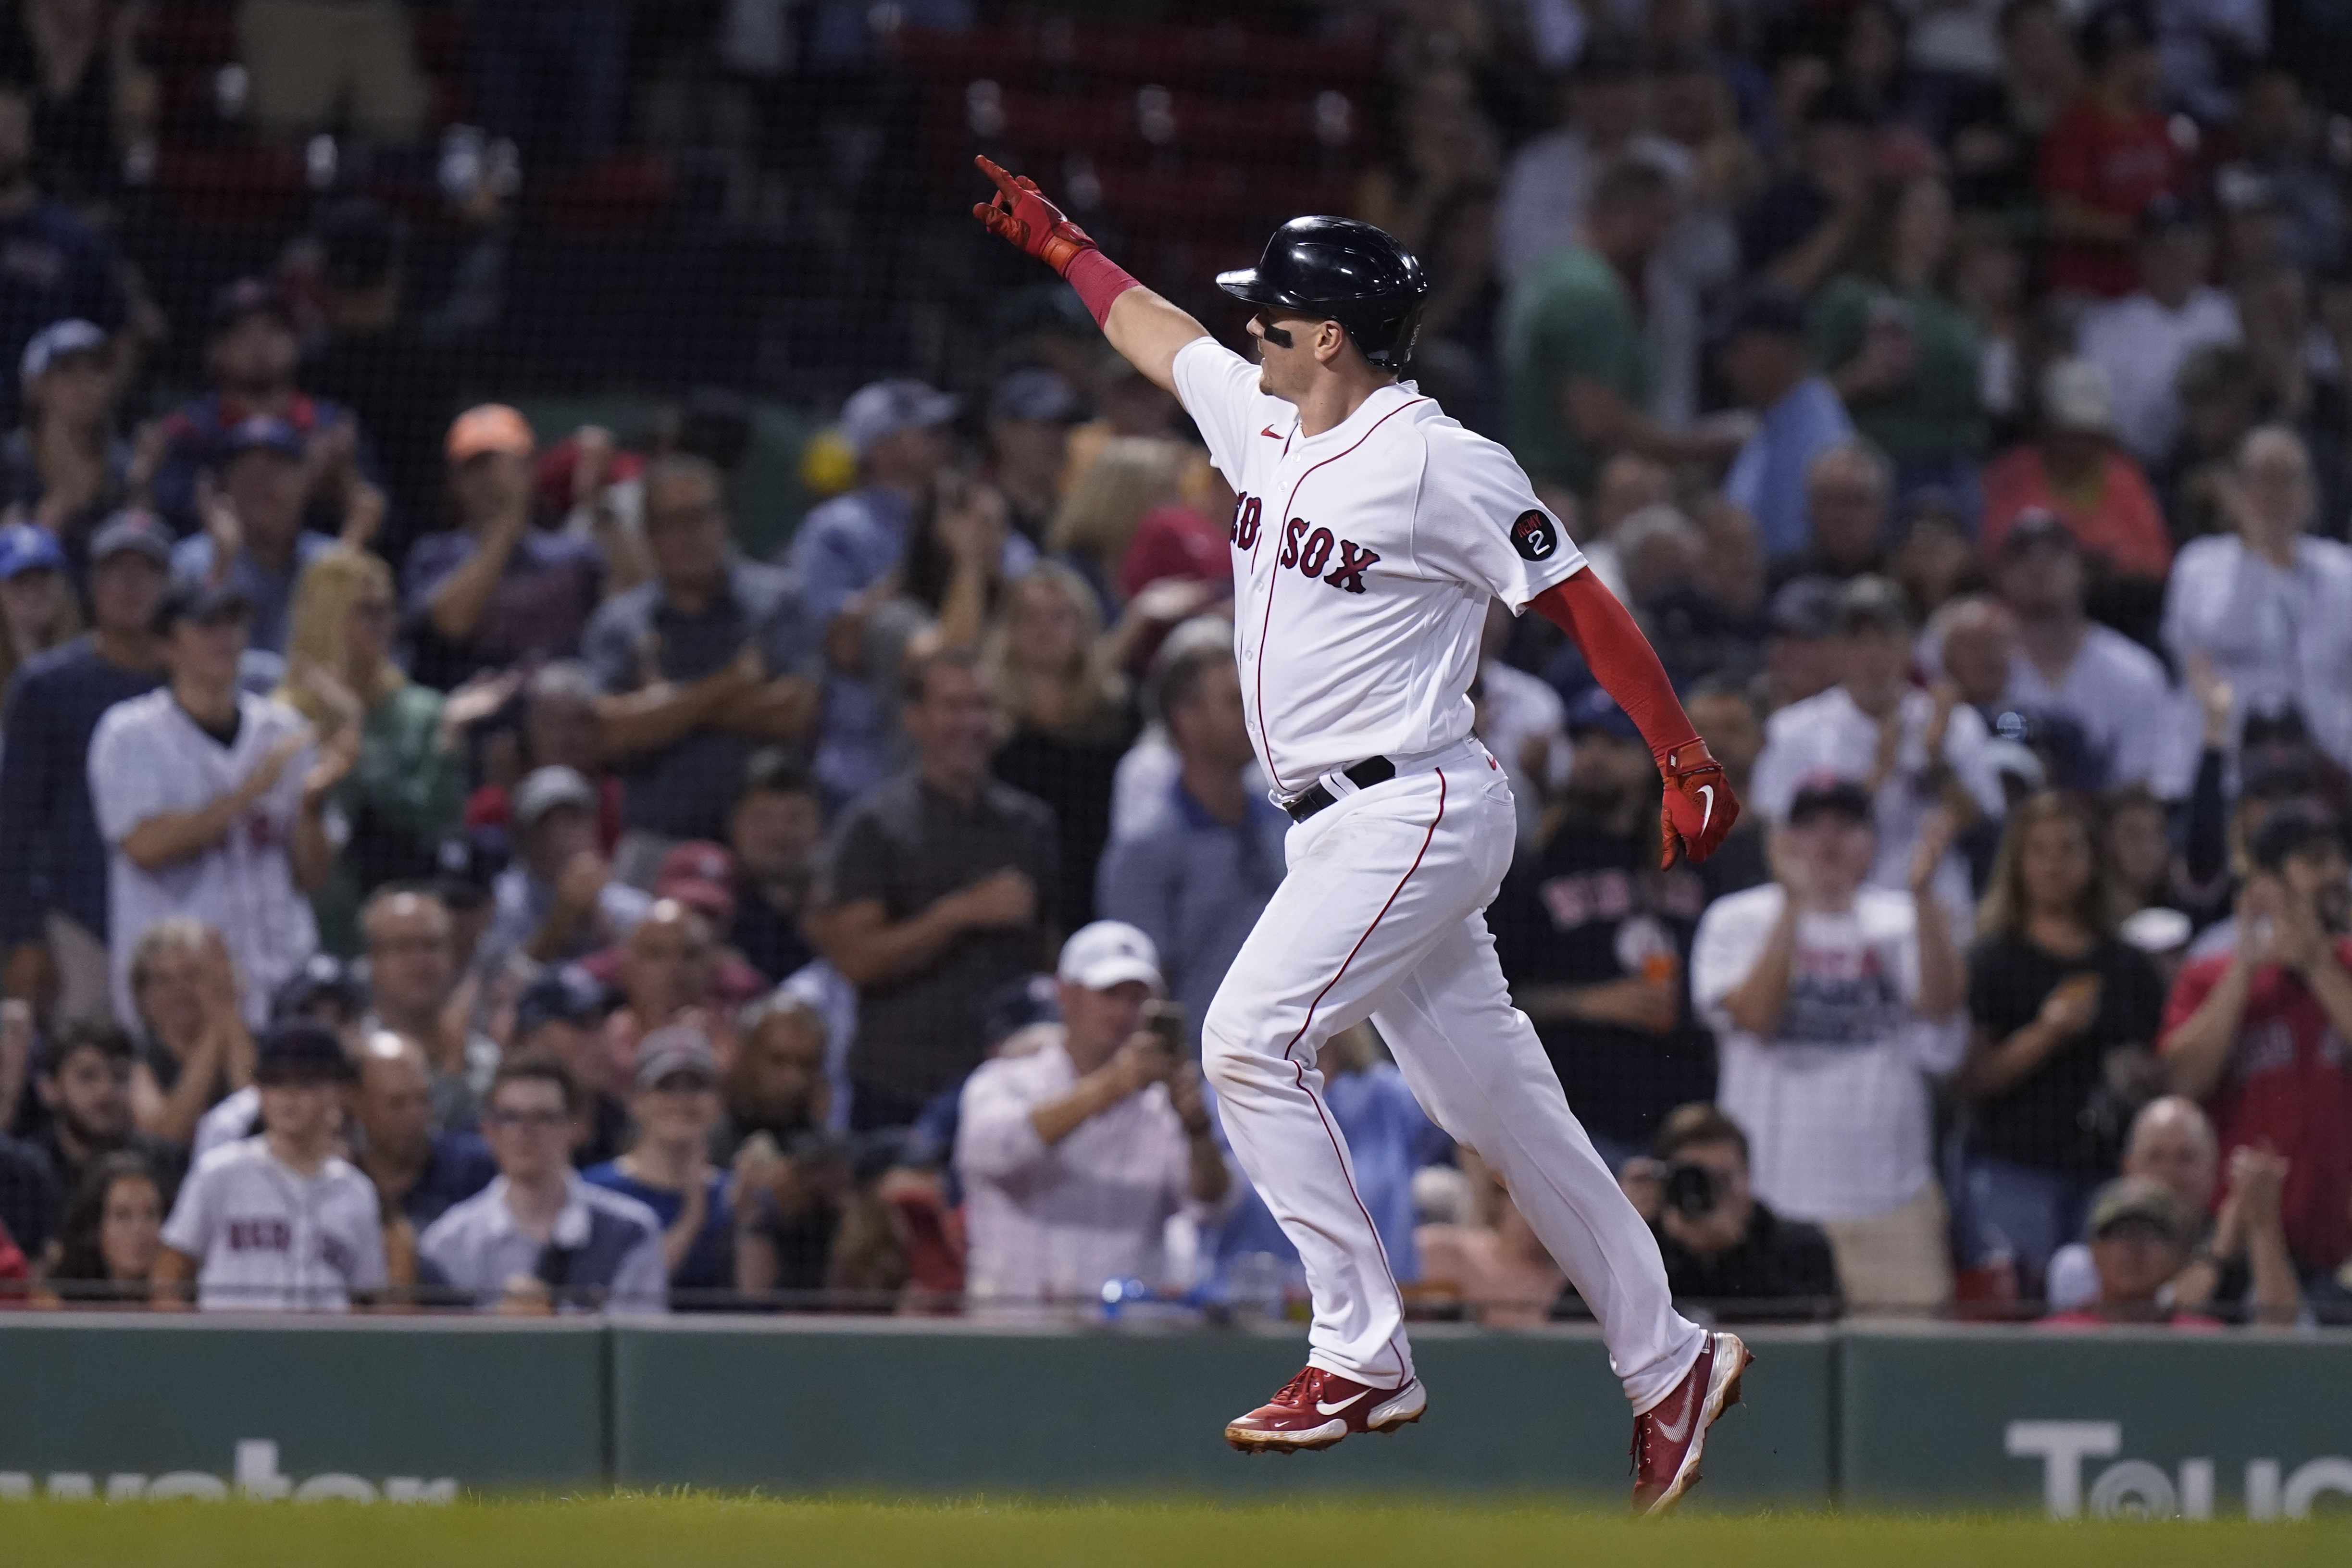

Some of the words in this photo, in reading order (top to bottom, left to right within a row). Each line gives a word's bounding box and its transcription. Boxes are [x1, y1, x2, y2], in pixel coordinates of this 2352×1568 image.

[1516, 513, 1542, 538] REMY
[1528, 530, 1550, 555] 2
[1280, 517, 1381, 594] SOX
